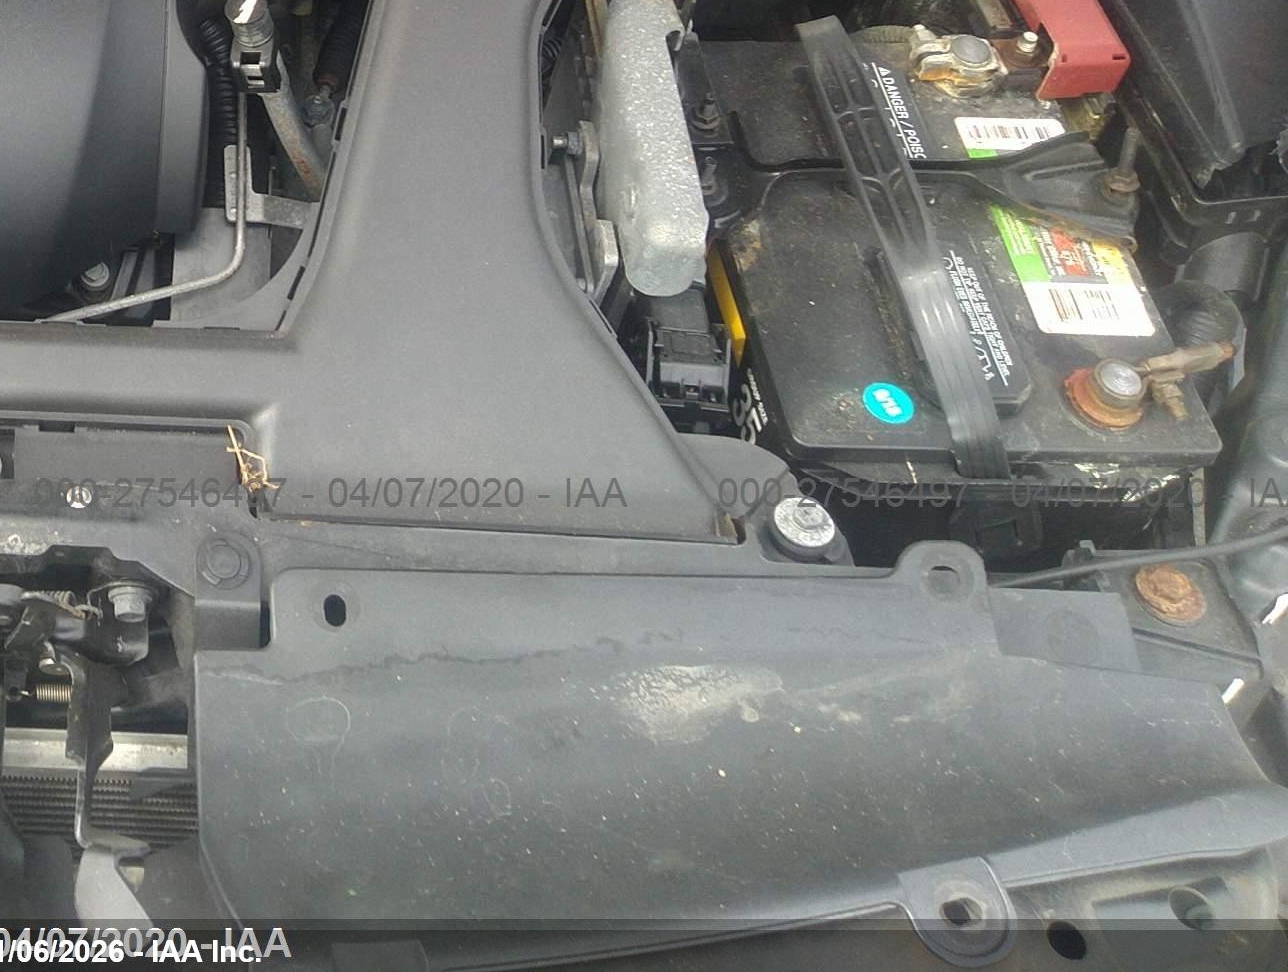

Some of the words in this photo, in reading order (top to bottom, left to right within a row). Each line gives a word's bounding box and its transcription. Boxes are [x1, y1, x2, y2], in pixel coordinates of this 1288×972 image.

[882, 77, 909, 118] DANGER
[900, 120, 914, 128] /
[967, 267, 977, 280] KEEP
[972, 281, 983, 292] OUT
[977, 292, 986, 300] OF
[981, 302, 992, 313] THE
